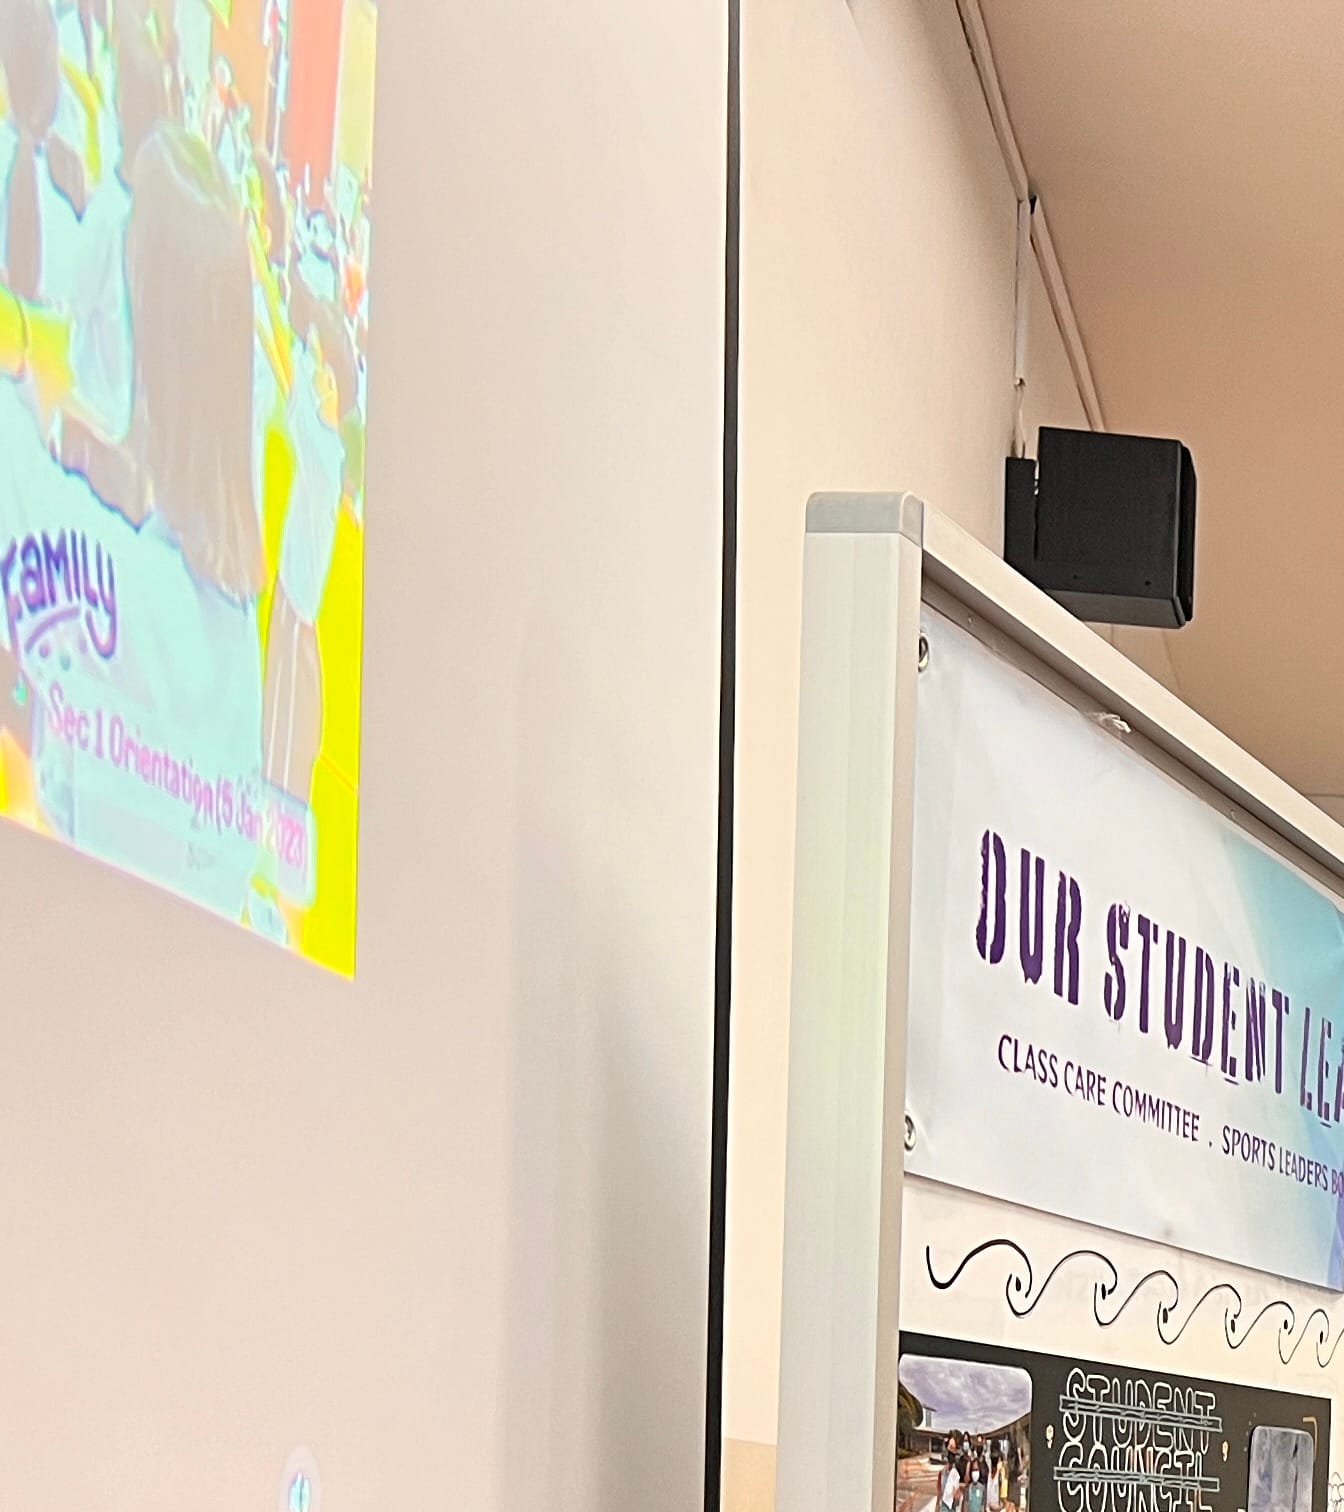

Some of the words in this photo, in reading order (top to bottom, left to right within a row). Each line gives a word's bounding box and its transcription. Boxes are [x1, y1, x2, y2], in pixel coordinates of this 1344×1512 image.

[49, 680, 89, 751] Sec
[109, 714, 214, 824] Orientation
[975, 829, 1083, 1006] OUR
[1103, 899, 1291, 1096] STUDENT
[998, 1034, 1058, 1088] CLASS
[1064, 1061, 1106, 1106] CARE
[1112, 1081, 1201, 1142] COMMITTEE
[1222, 1125, 1276, 1171] SPORTS
[1279, 1150, 1328, 1191] LEADERS
[1063, 1367, 1216, 1455] STUDENT
